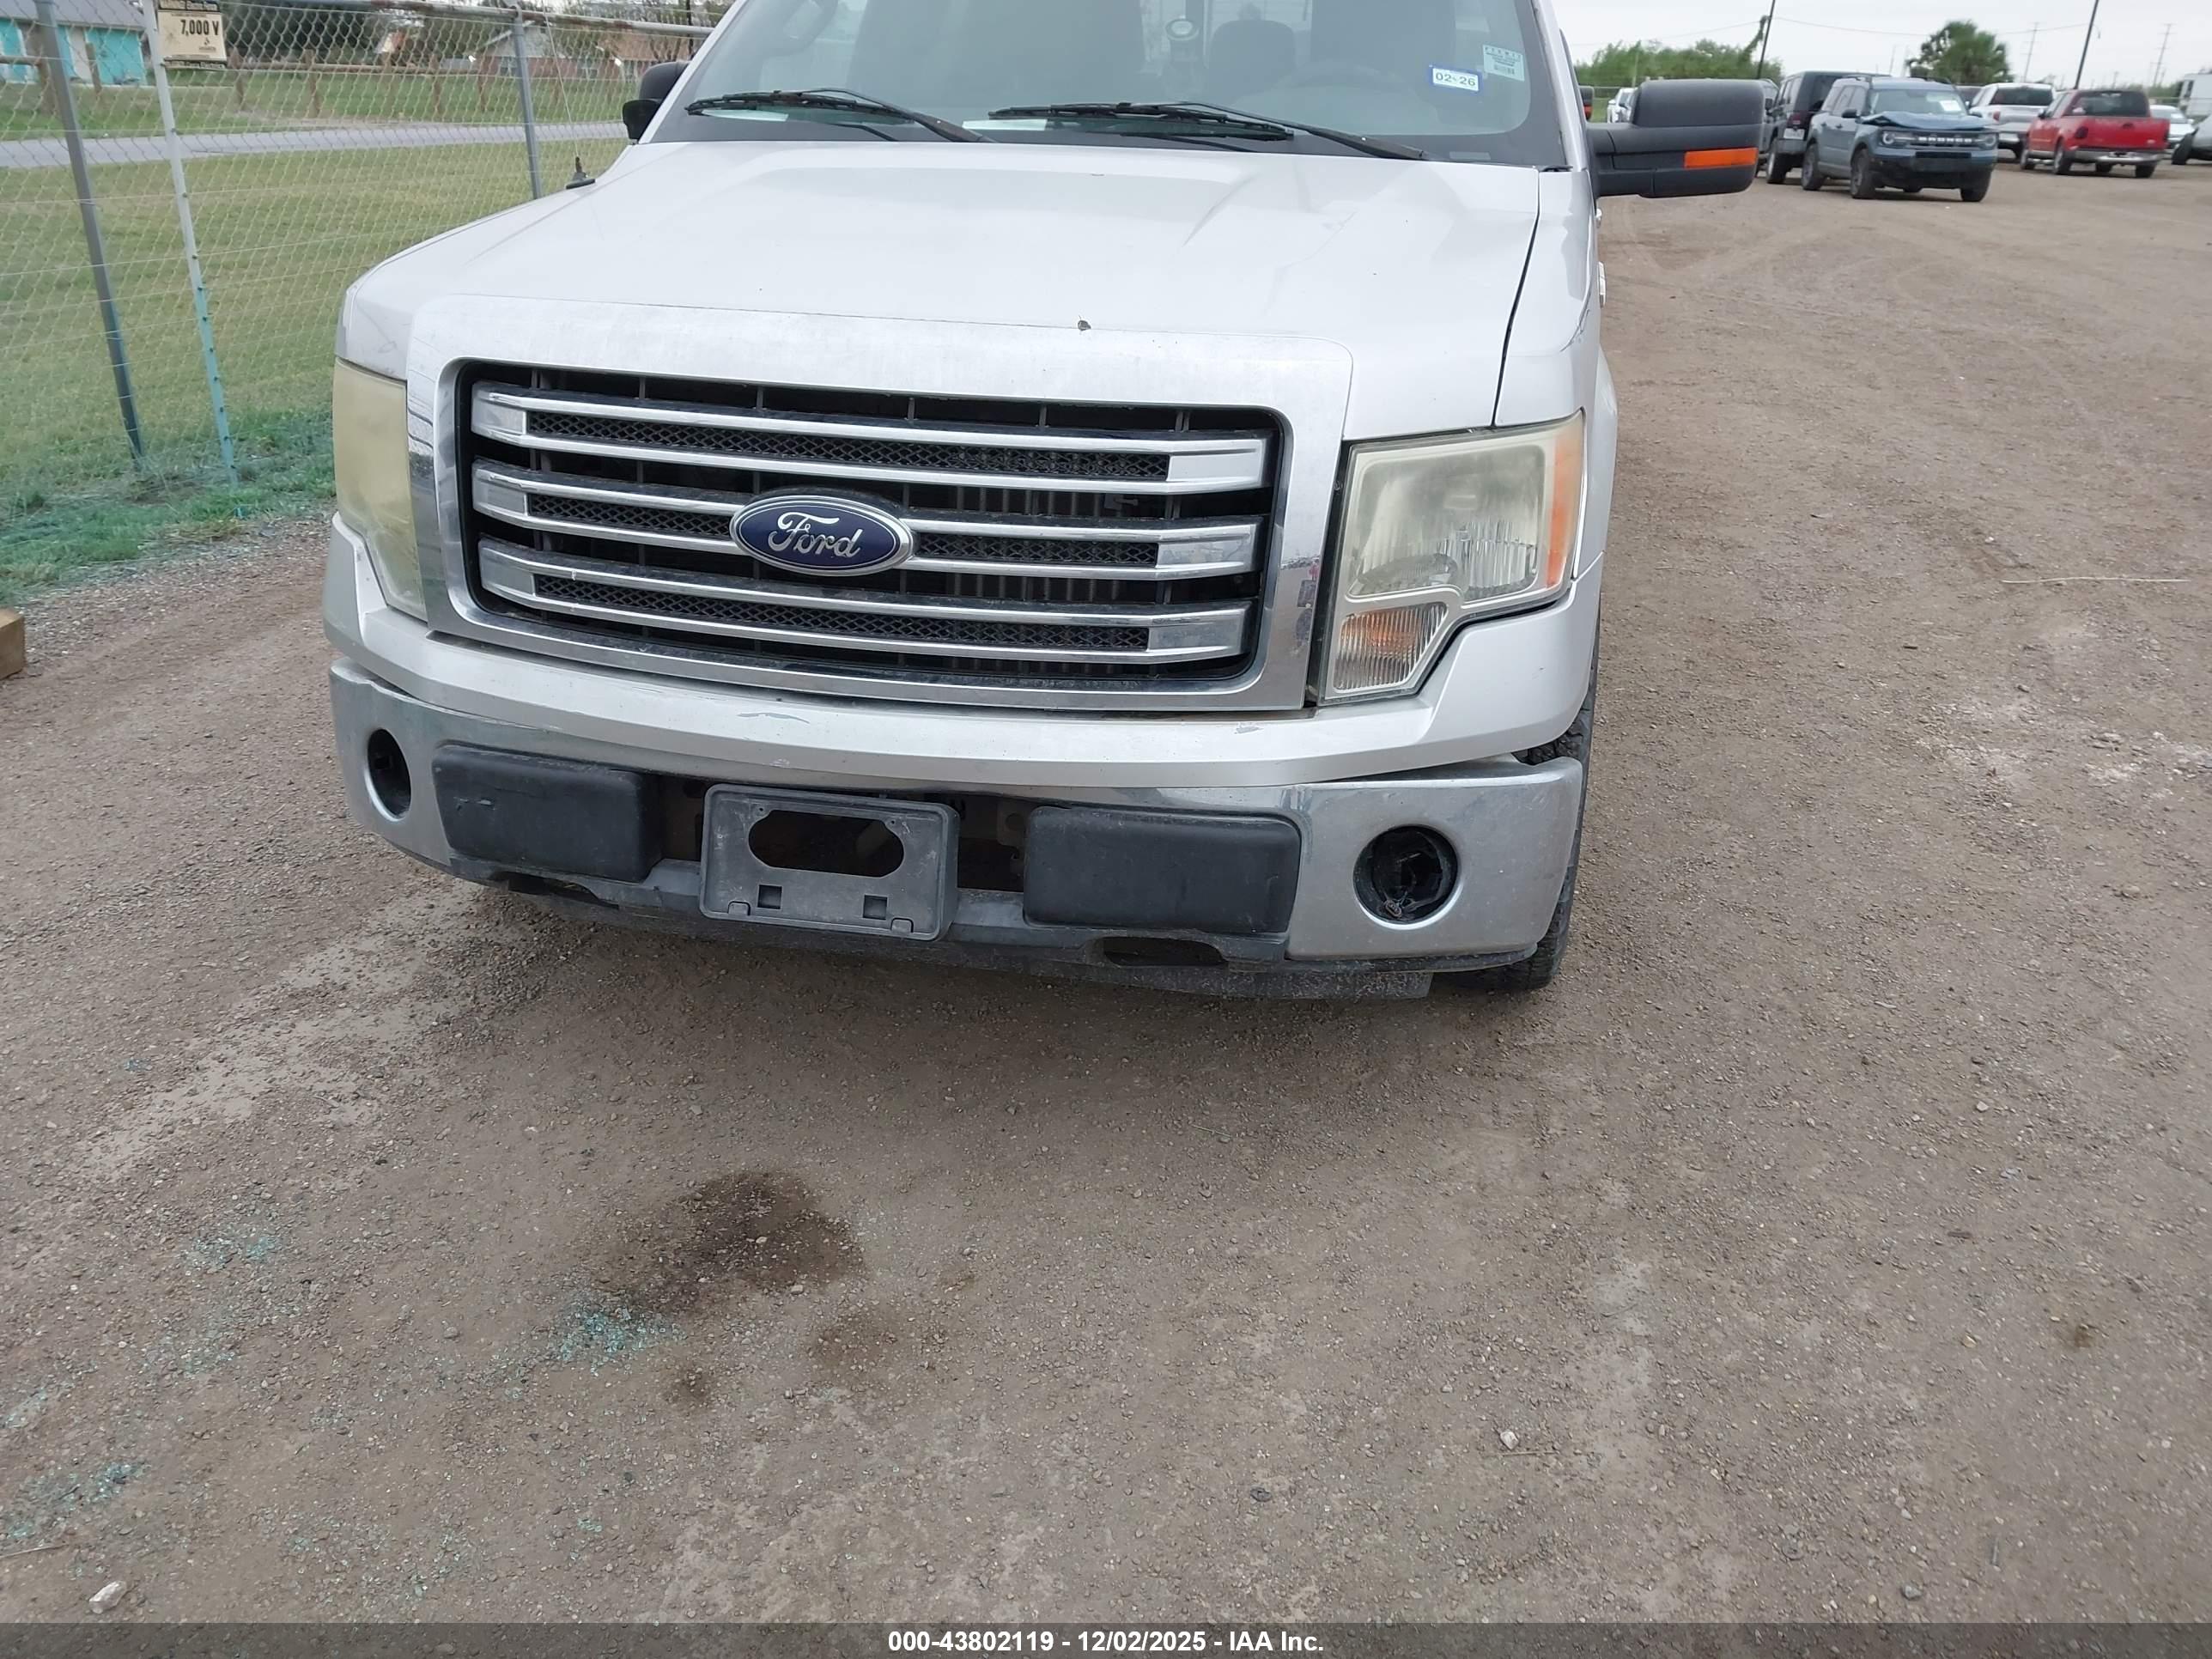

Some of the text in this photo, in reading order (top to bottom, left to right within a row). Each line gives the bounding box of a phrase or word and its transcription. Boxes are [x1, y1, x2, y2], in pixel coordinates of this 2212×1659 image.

[180, 19, 220, 37] 7,000 V
[768, 511, 864, 557] Ford
